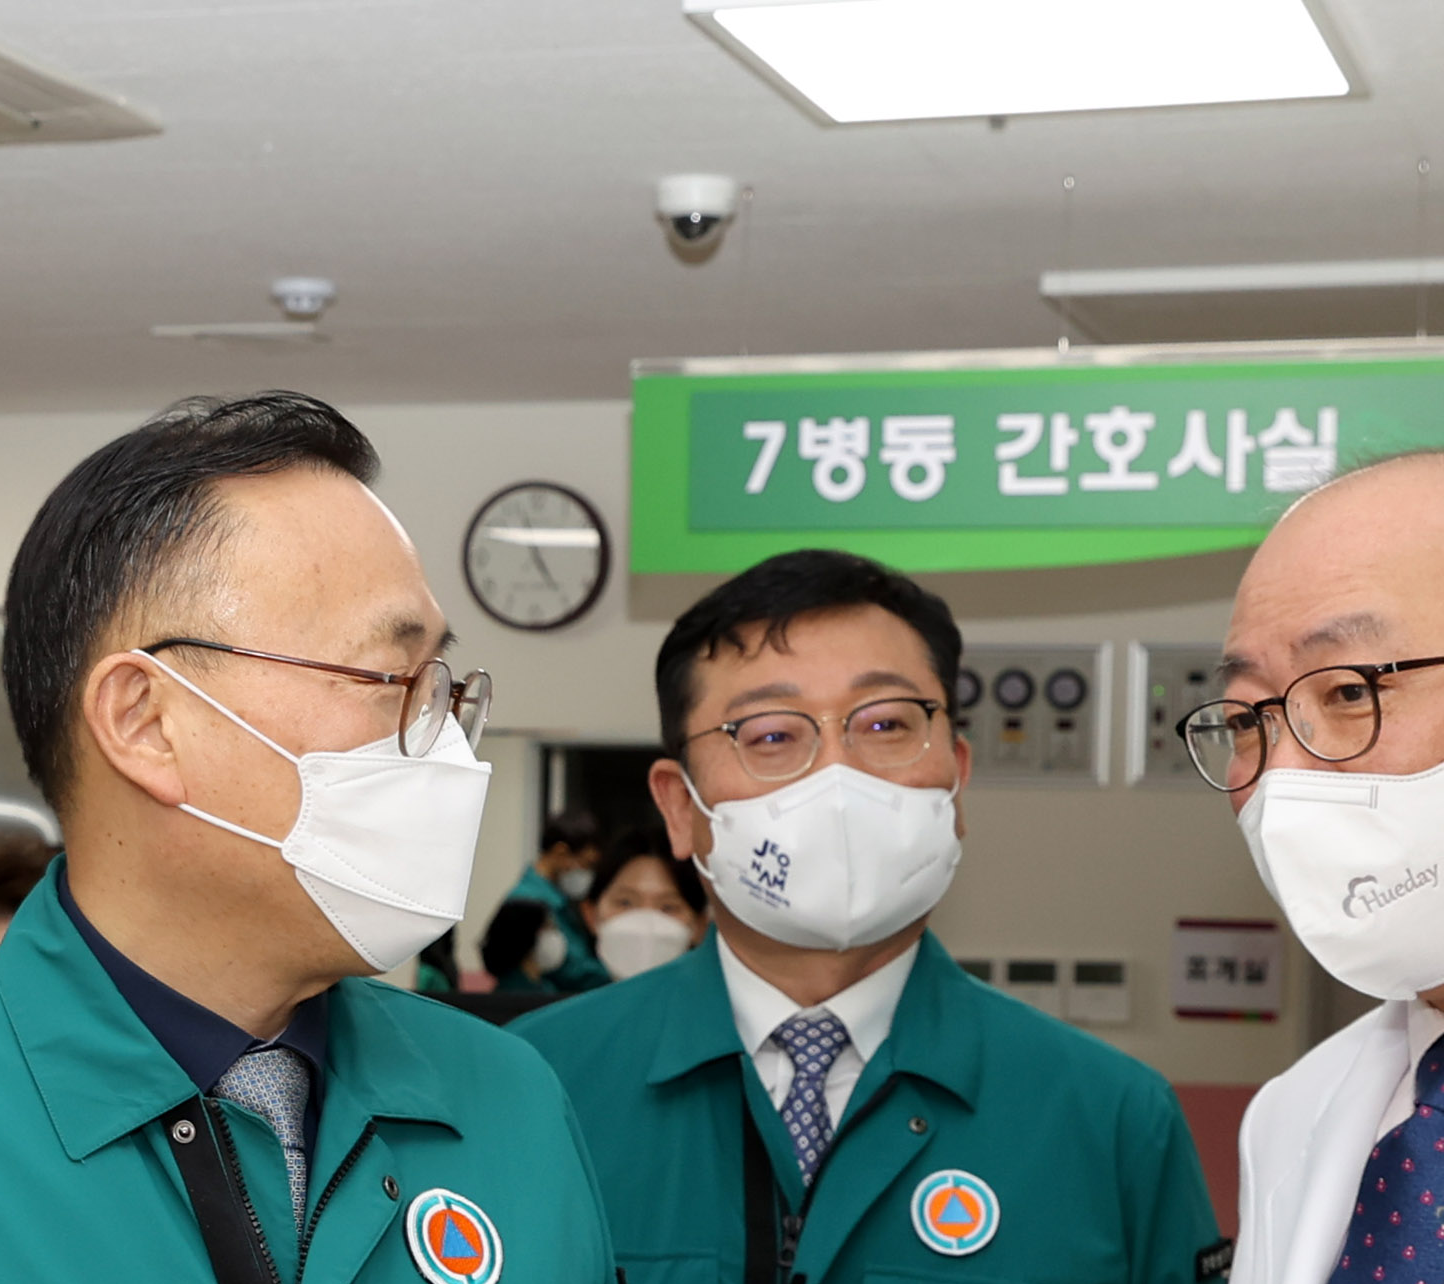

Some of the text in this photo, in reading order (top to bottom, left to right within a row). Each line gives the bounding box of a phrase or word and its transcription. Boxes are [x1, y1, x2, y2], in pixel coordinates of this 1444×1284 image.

[742, 405, 1340, 501] 7병동 간호사실
[1357, 863, 1438, 914] Hueday
